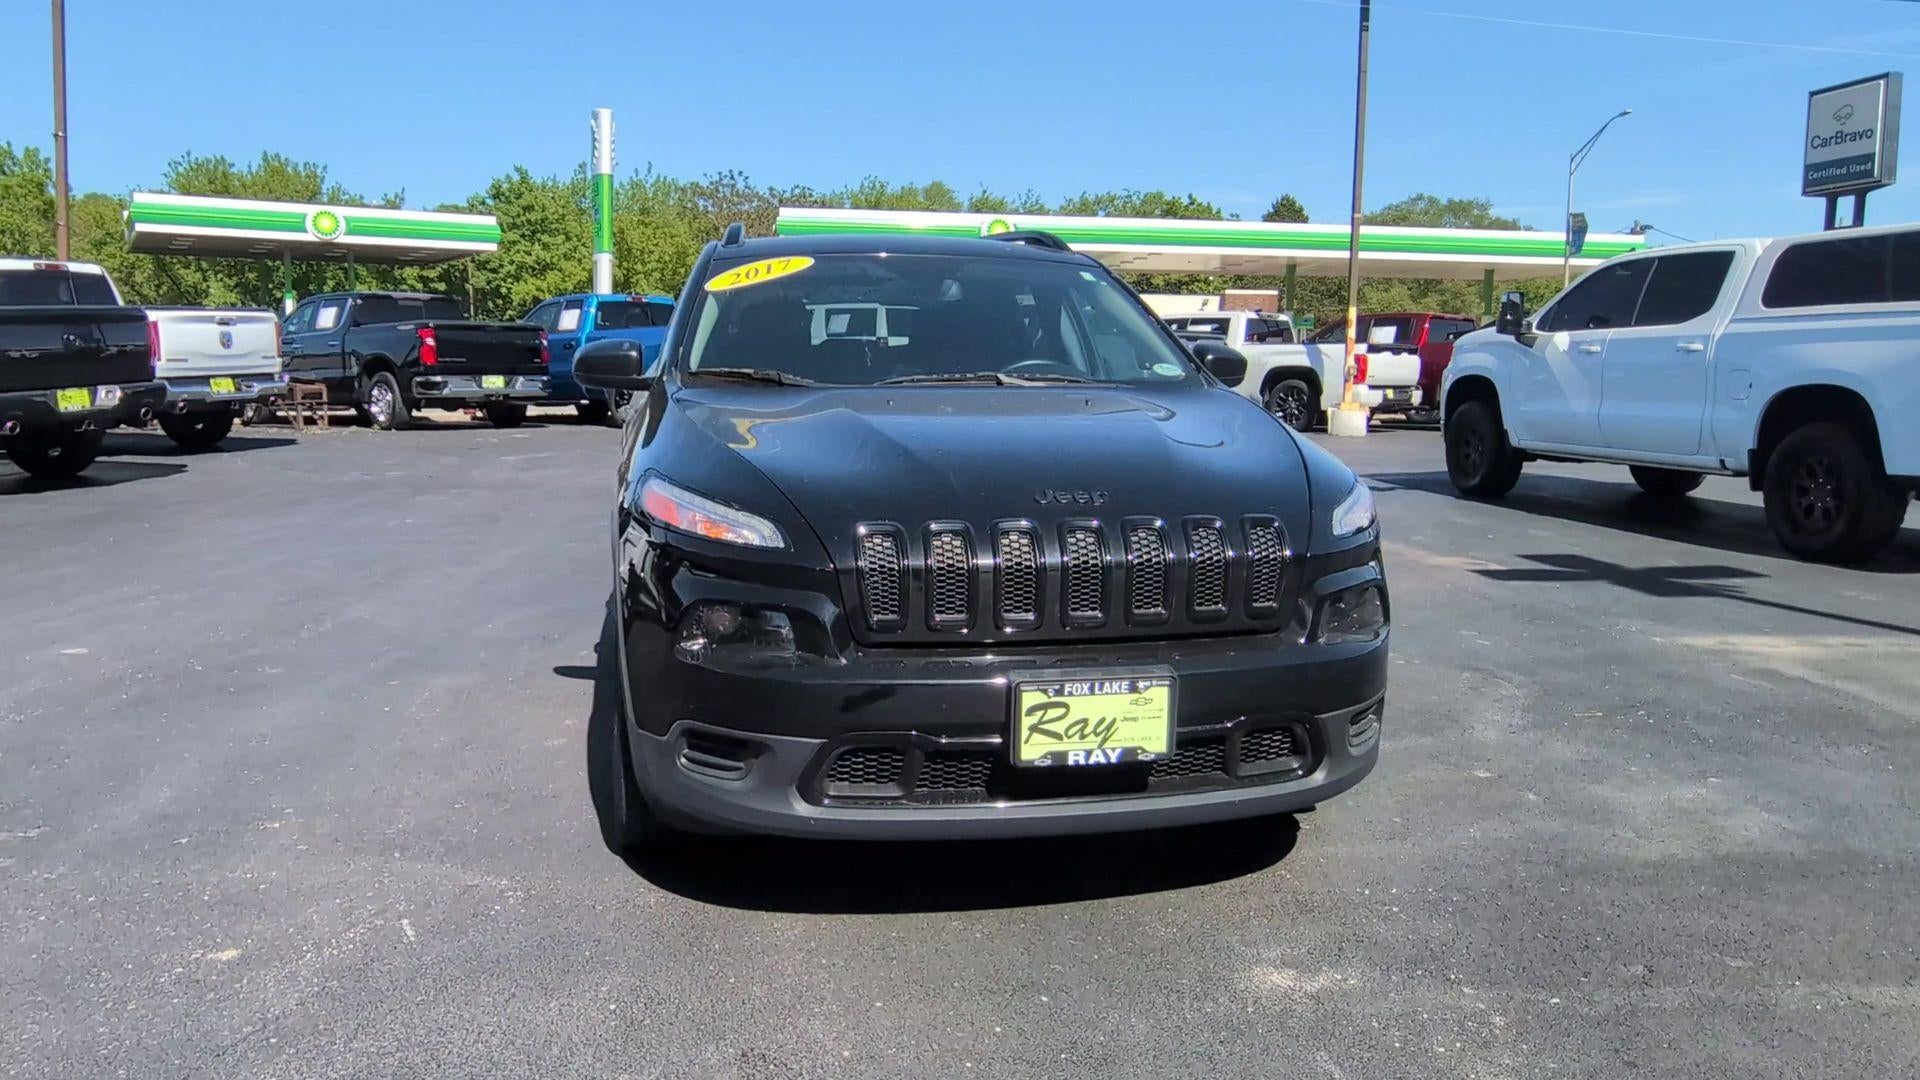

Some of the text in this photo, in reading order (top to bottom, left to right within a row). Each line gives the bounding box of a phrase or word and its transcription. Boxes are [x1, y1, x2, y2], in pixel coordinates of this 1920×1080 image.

[1810, 128, 1874, 149] CarBravo
[1808, 162, 1872, 180] Certified Used
[728, 259, 792, 287] 2017
[1033, 488, 1110, 506] Jeep
[1064, 683, 1091, 695] FOX
[1095, 681, 1130, 694] LAKE
[1024, 700, 1119, 748] Ray
[1068, 748, 1122, 765] RAY
